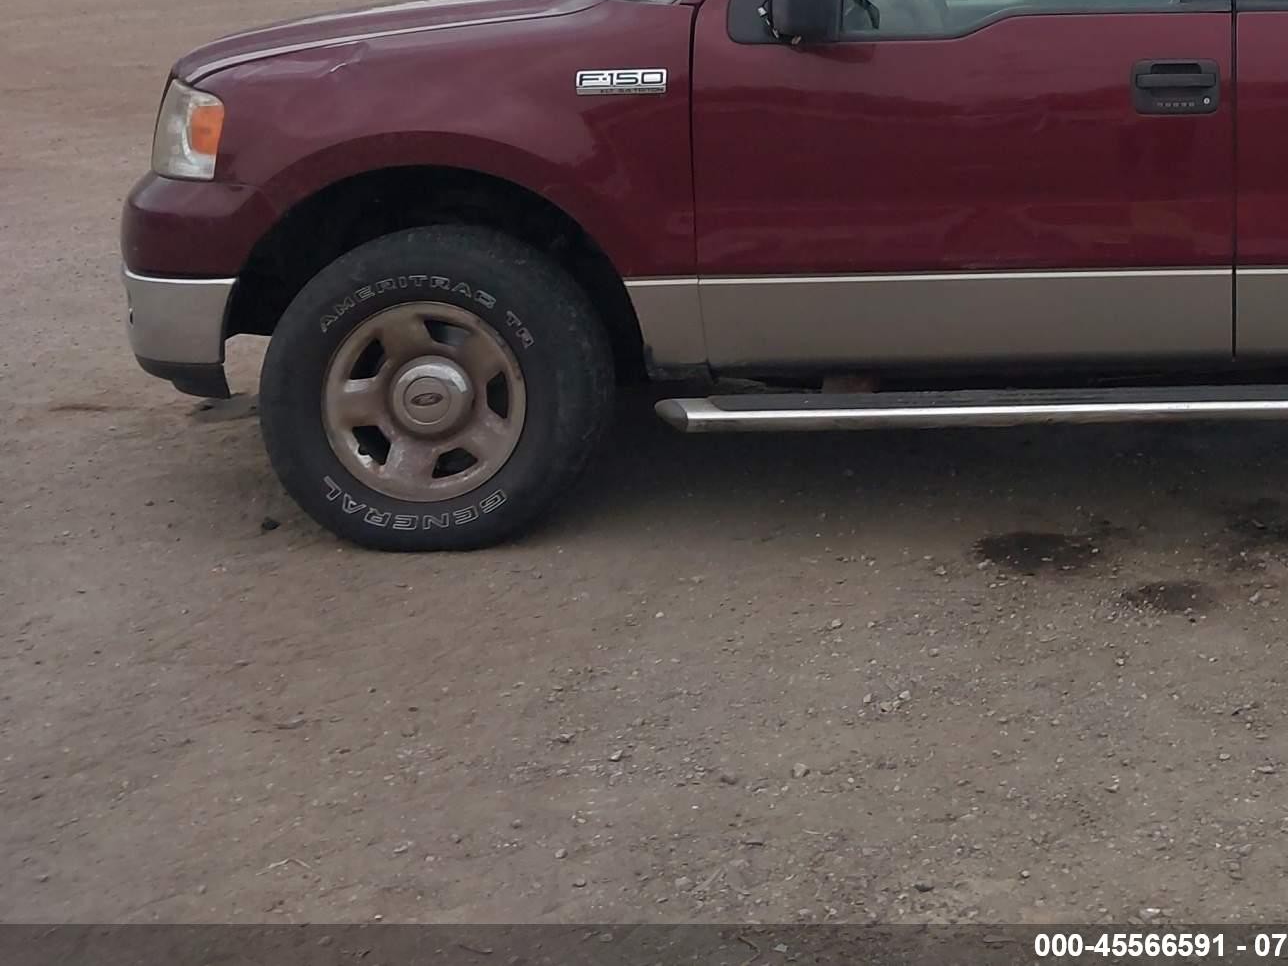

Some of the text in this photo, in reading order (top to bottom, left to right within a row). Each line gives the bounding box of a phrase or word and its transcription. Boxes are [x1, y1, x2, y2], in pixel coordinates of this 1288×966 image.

[319, 274, 536, 349] AMERITRAC TR
[323, 475, 508, 531] GENERAL
